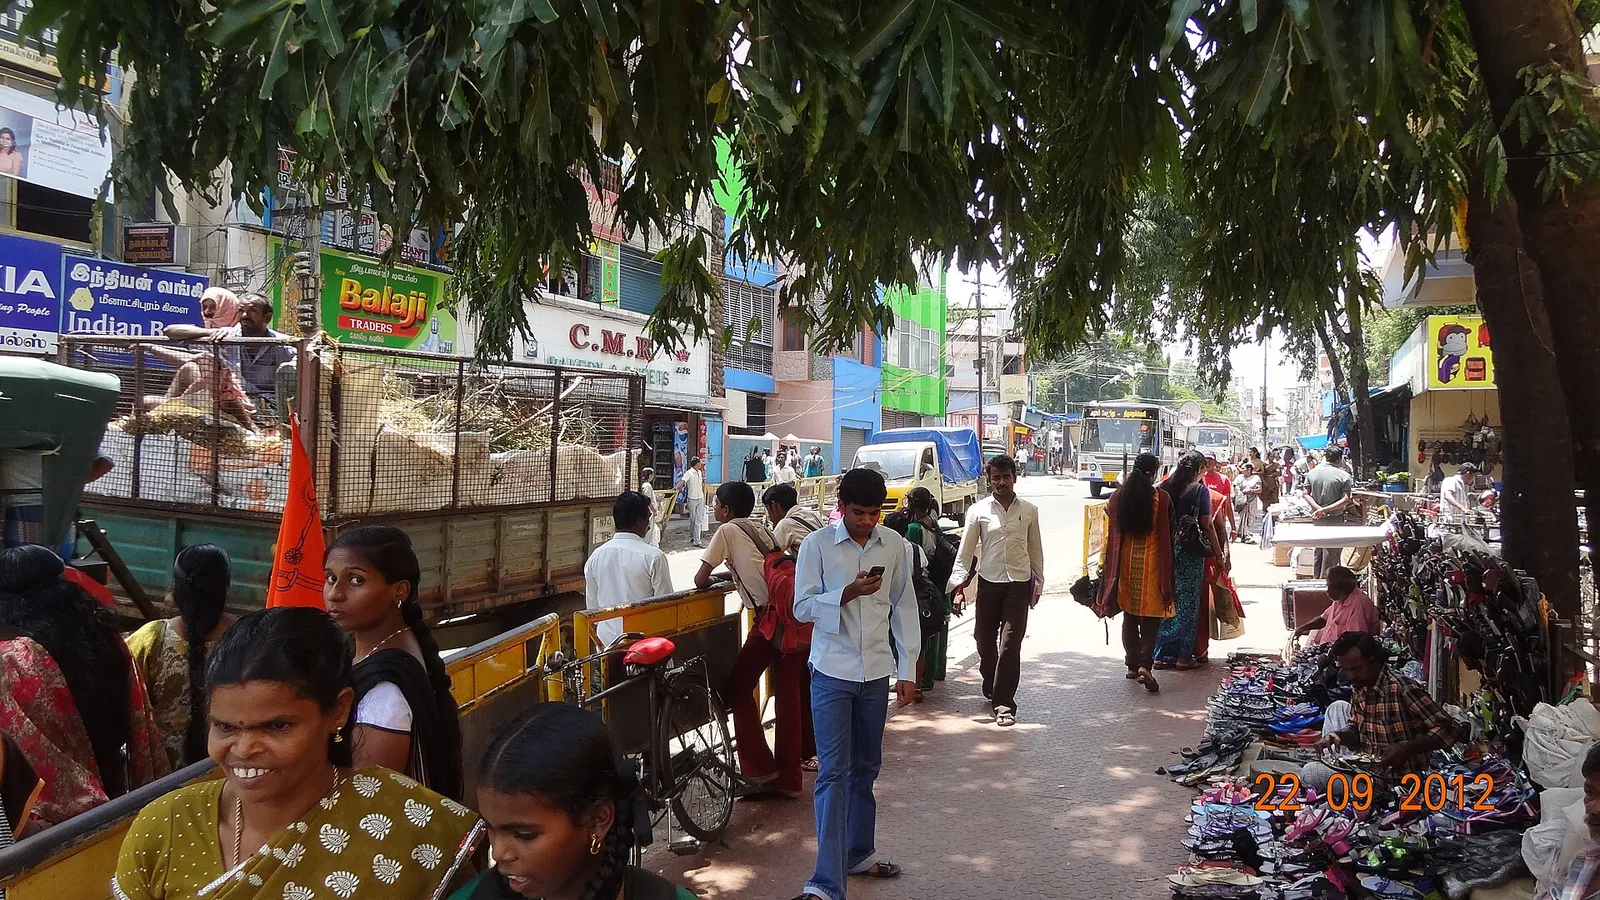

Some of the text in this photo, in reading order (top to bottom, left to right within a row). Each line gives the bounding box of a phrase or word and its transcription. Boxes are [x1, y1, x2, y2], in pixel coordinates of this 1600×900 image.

[0, 264, 56, 299] IA
[70, 262, 153, 291] இந்தியன்
[17, 303, 51, 317] People
[99, 293, 160, 312] மீனாட்சிபுரம்
[340, 277, 428, 329] Balaji
[67, 310, 143, 336] Indian
[349, 318, 393, 334] TRADERS
